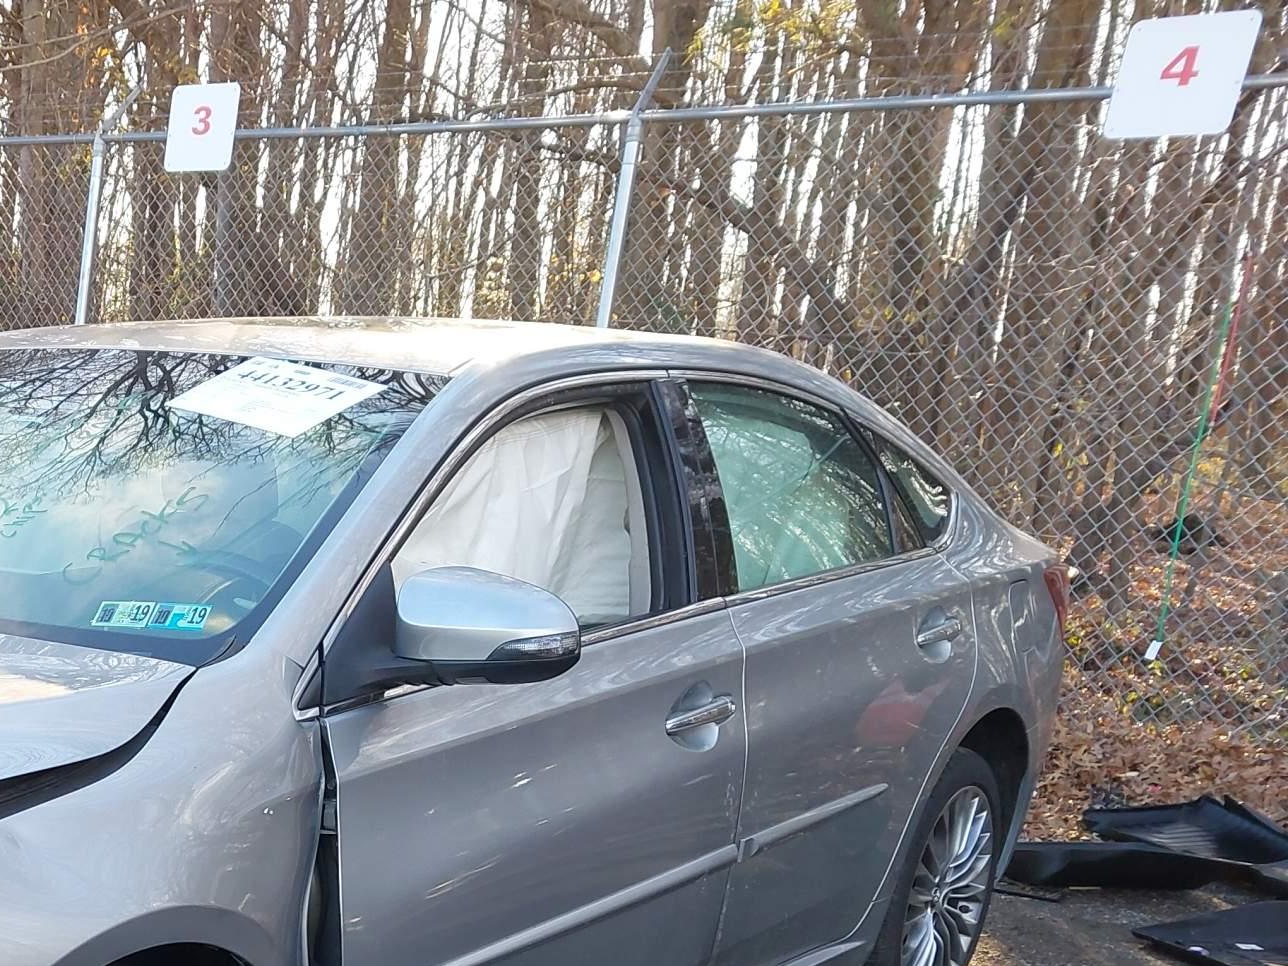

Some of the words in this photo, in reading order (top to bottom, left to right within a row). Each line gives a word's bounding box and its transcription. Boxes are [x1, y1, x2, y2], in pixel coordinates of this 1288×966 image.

[1160, 45, 1200, 86] 4
[191, 105, 212, 135] 3
[238, 369, 344, 400] 44132971
[130, 604, 150, 621] 19
[187, 607, 208, 625] 19
